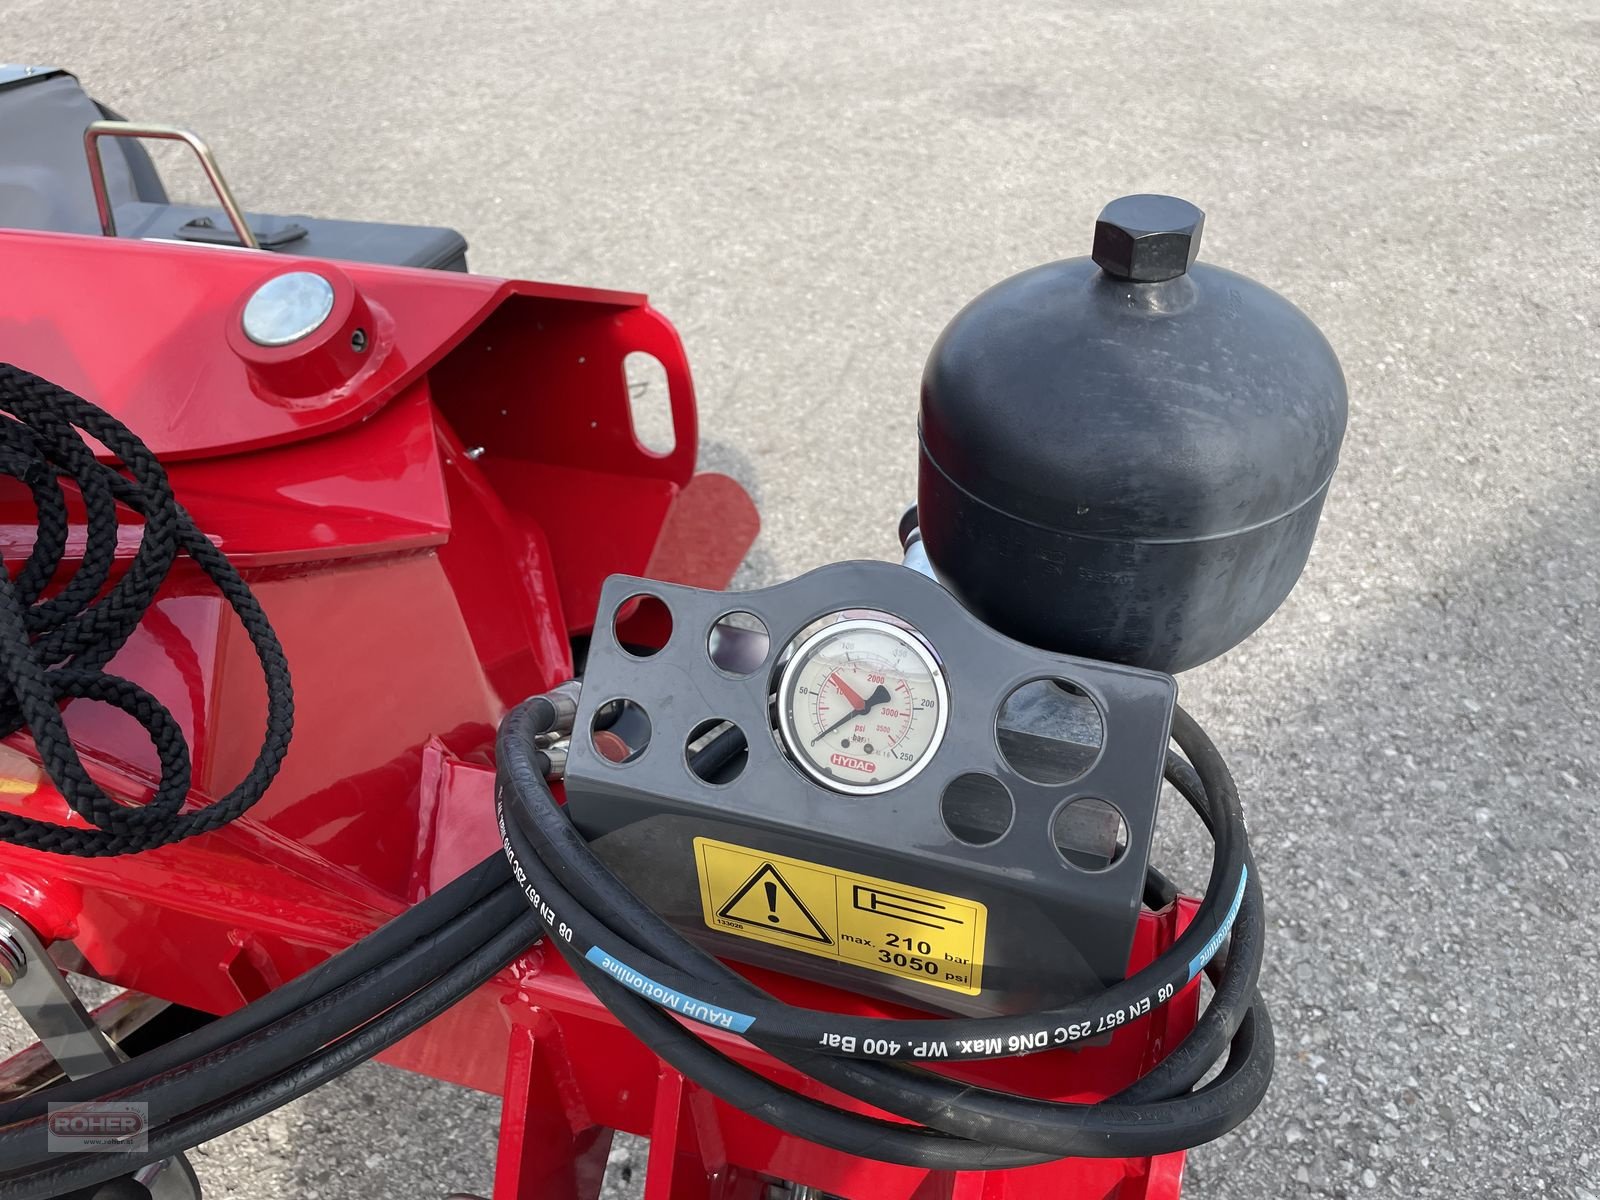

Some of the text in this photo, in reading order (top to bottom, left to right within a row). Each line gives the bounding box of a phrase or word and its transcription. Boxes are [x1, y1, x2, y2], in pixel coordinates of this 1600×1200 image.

[867, 674, 885, 684] 2000
[799, 687, 809, 696] 50
[880, 707, 899, 718] 3000
[920, 699, 935, 709] 200
[854, 724, 866, 733] psi
[832, 754, 874, 772] HYDAC
[899, 752, 914, 763] 250
[513, 859, 527, 888] 2SC
[524, 884, 541, 909] 857
[540, 901, 556, 927] EN
[841, 933, 969, 965] max. 210 bar
[878, 949, 968, 984] 3050 psi
[602, 957, 733, 1028] RAUH Motionline
[819, 983, 1174, 1057] 08 EN 857 2SC DN6 Max. WP. 400 Bar
